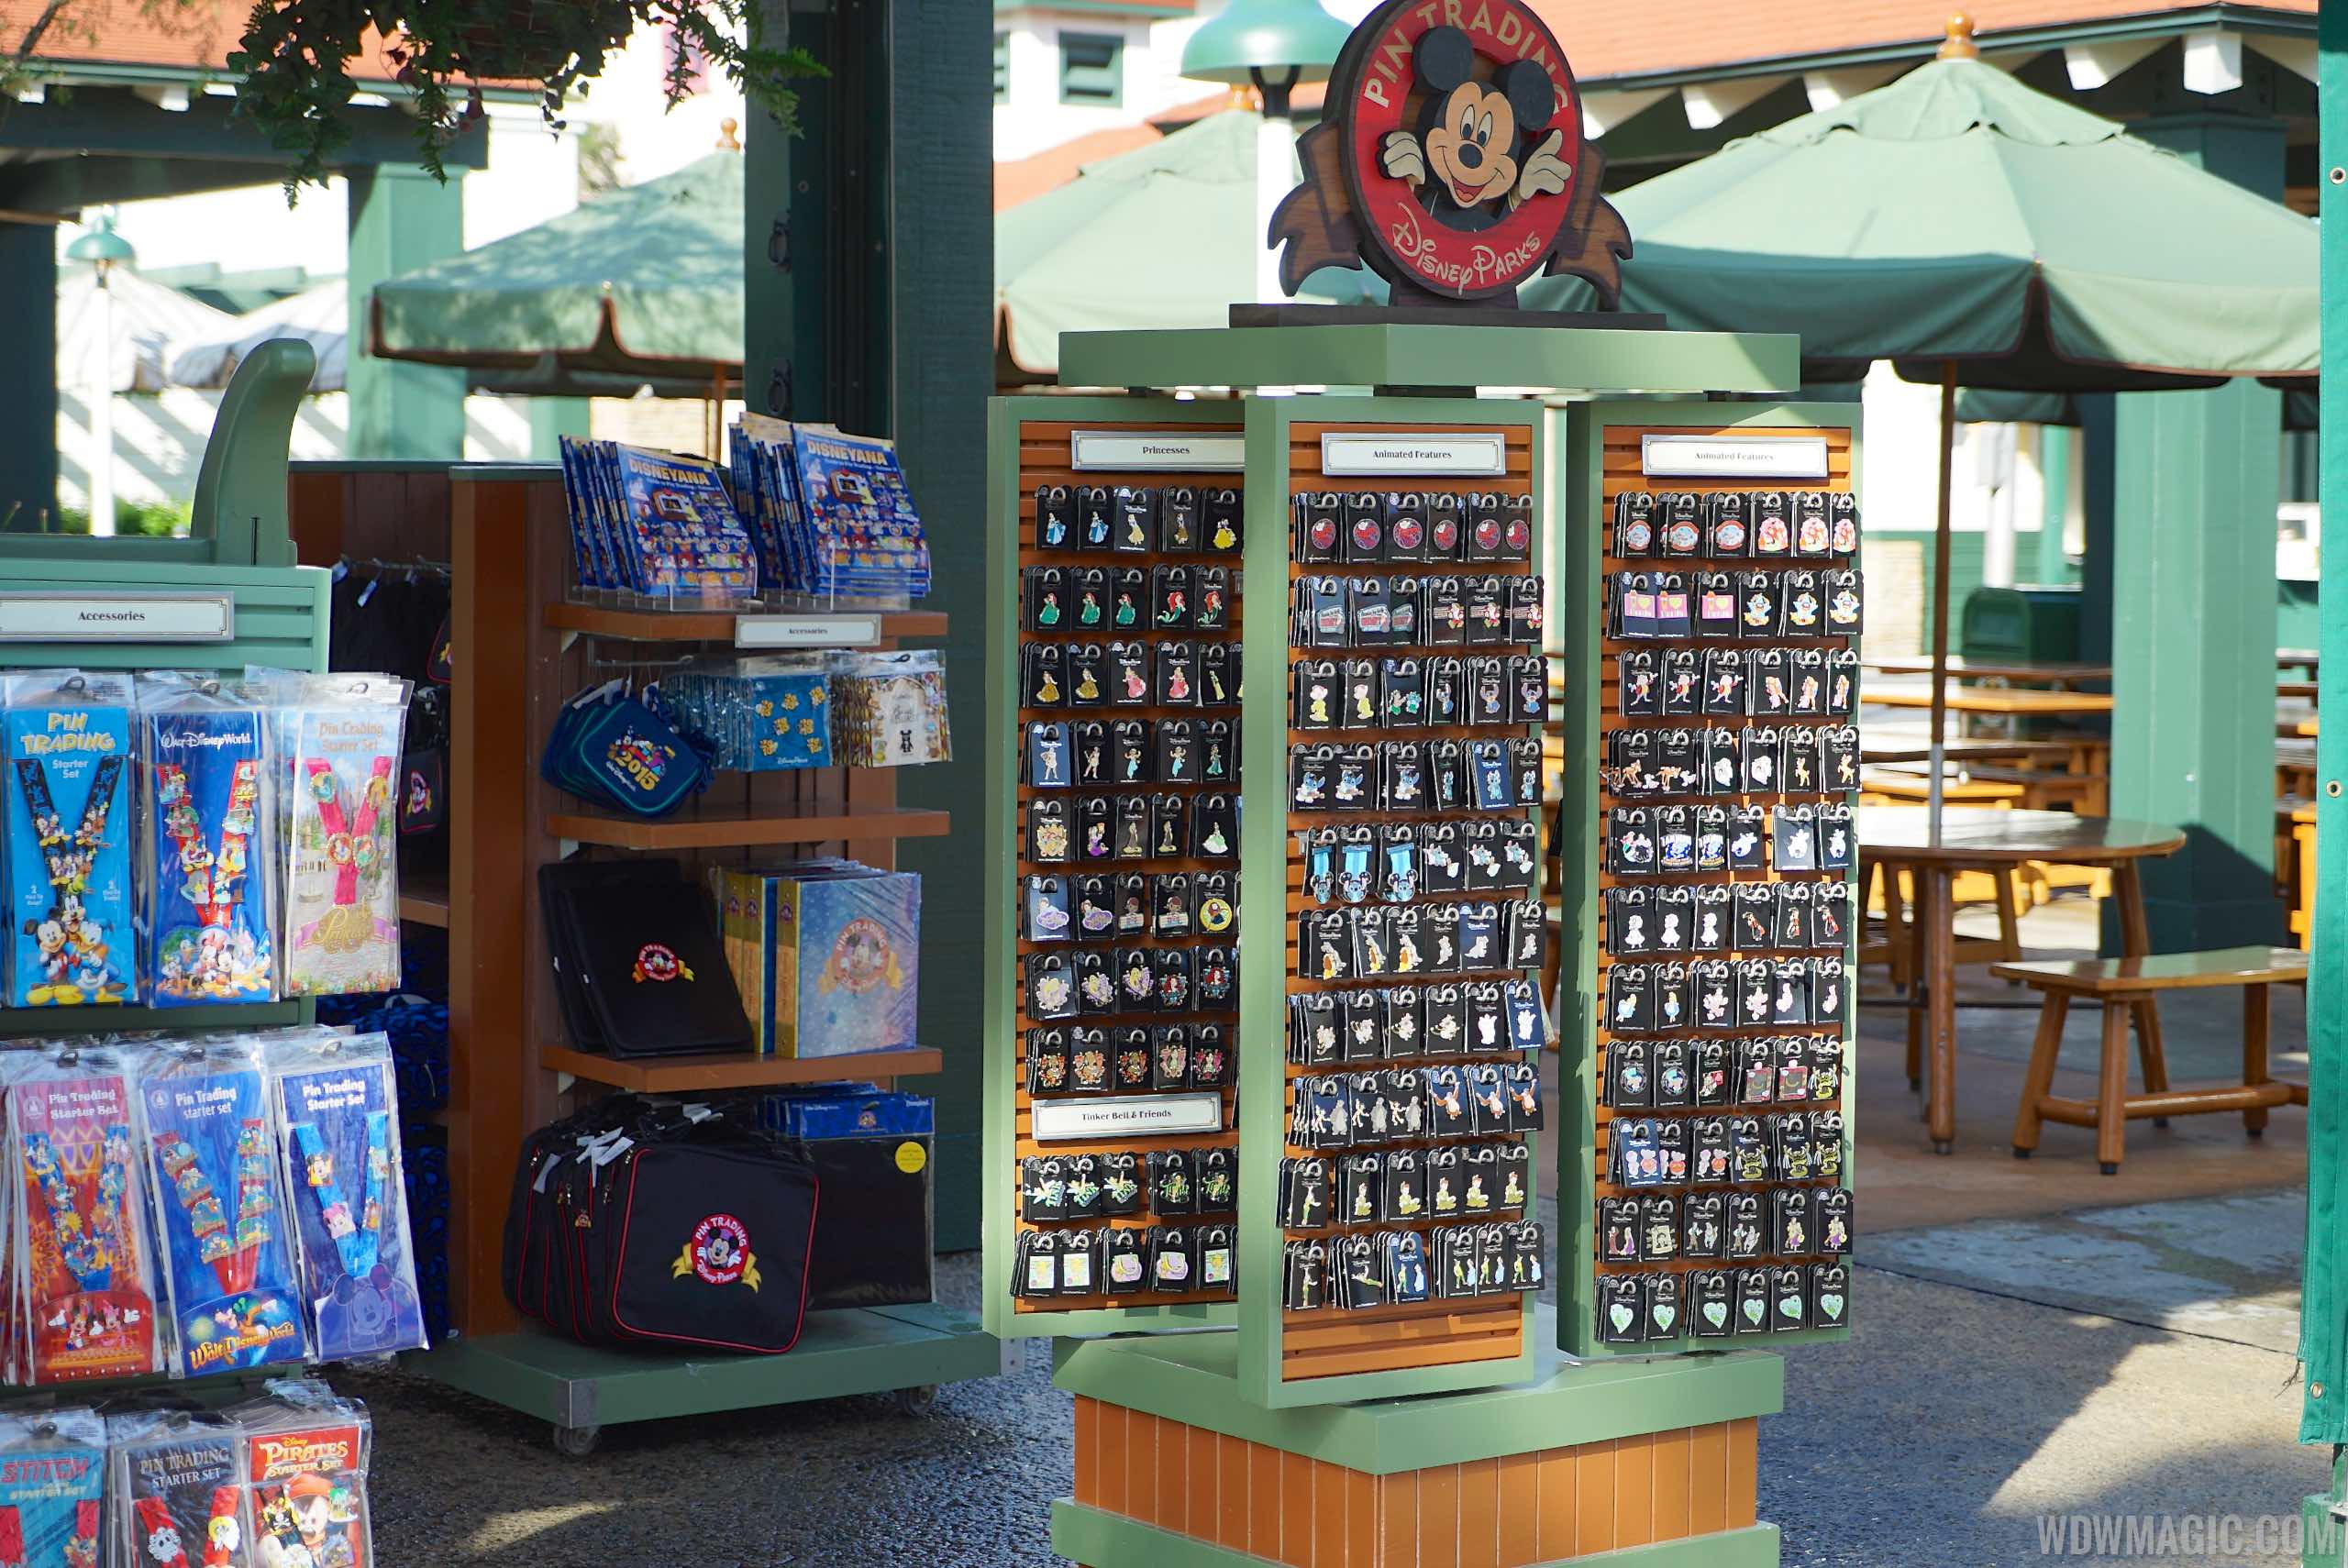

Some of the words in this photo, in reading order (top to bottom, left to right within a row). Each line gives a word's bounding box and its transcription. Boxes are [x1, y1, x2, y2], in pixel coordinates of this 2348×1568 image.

[1363, 28, 1413, 108] PIN
[807, 440, 889, 466] DISNEYANA
[1142, 446, 1191, 455] Princesses
[1372, 449, 1413, 458] Animated
[1415, 449, 1453, 459] Features
[1694, 451, 1736, 460] Animated
[1737, 452, 1775, 461] Features
[628, 458, 711, 485] DISNEYANA
[79, 610, 146, 621] Accessories
[789, 627, 829, 635] Accessories
[47, 712, 89, 734] PIN
[20, 732, 116, 756] TRADING
[52, 758, 89, 769] Starter
[62, 768, 81, 778] Set
[49, 1093, 67, 1104] Pin
[71, 1088, 116, 1103] Trading
[175, 1092, 194, 1107] Pin
[196, 1086, 237, 1103] Trading
[303, 1084, 321, 1098] Pin
[323, 1078, 366, 1093] Trading
[1081, 1112, 1110, 1121] Tinker
[1112, 1111, 1129, 1120] Bell
[1131, 1110, 1137, 1119] &
[1139, 1110, 1172, 1119] Friends
[695, 1221, 711, 1240] PIN
[710, 1217, 747, 1247] TRADING
[139, 1457, 165, 1475] PIN
[165, 1447, 230, 1472] TRADING
[258, 1441, 349, 1468] PIRATES
[152, 1470, 201, 1488] STARTER
[201, 1466, 222, 1481] SET
